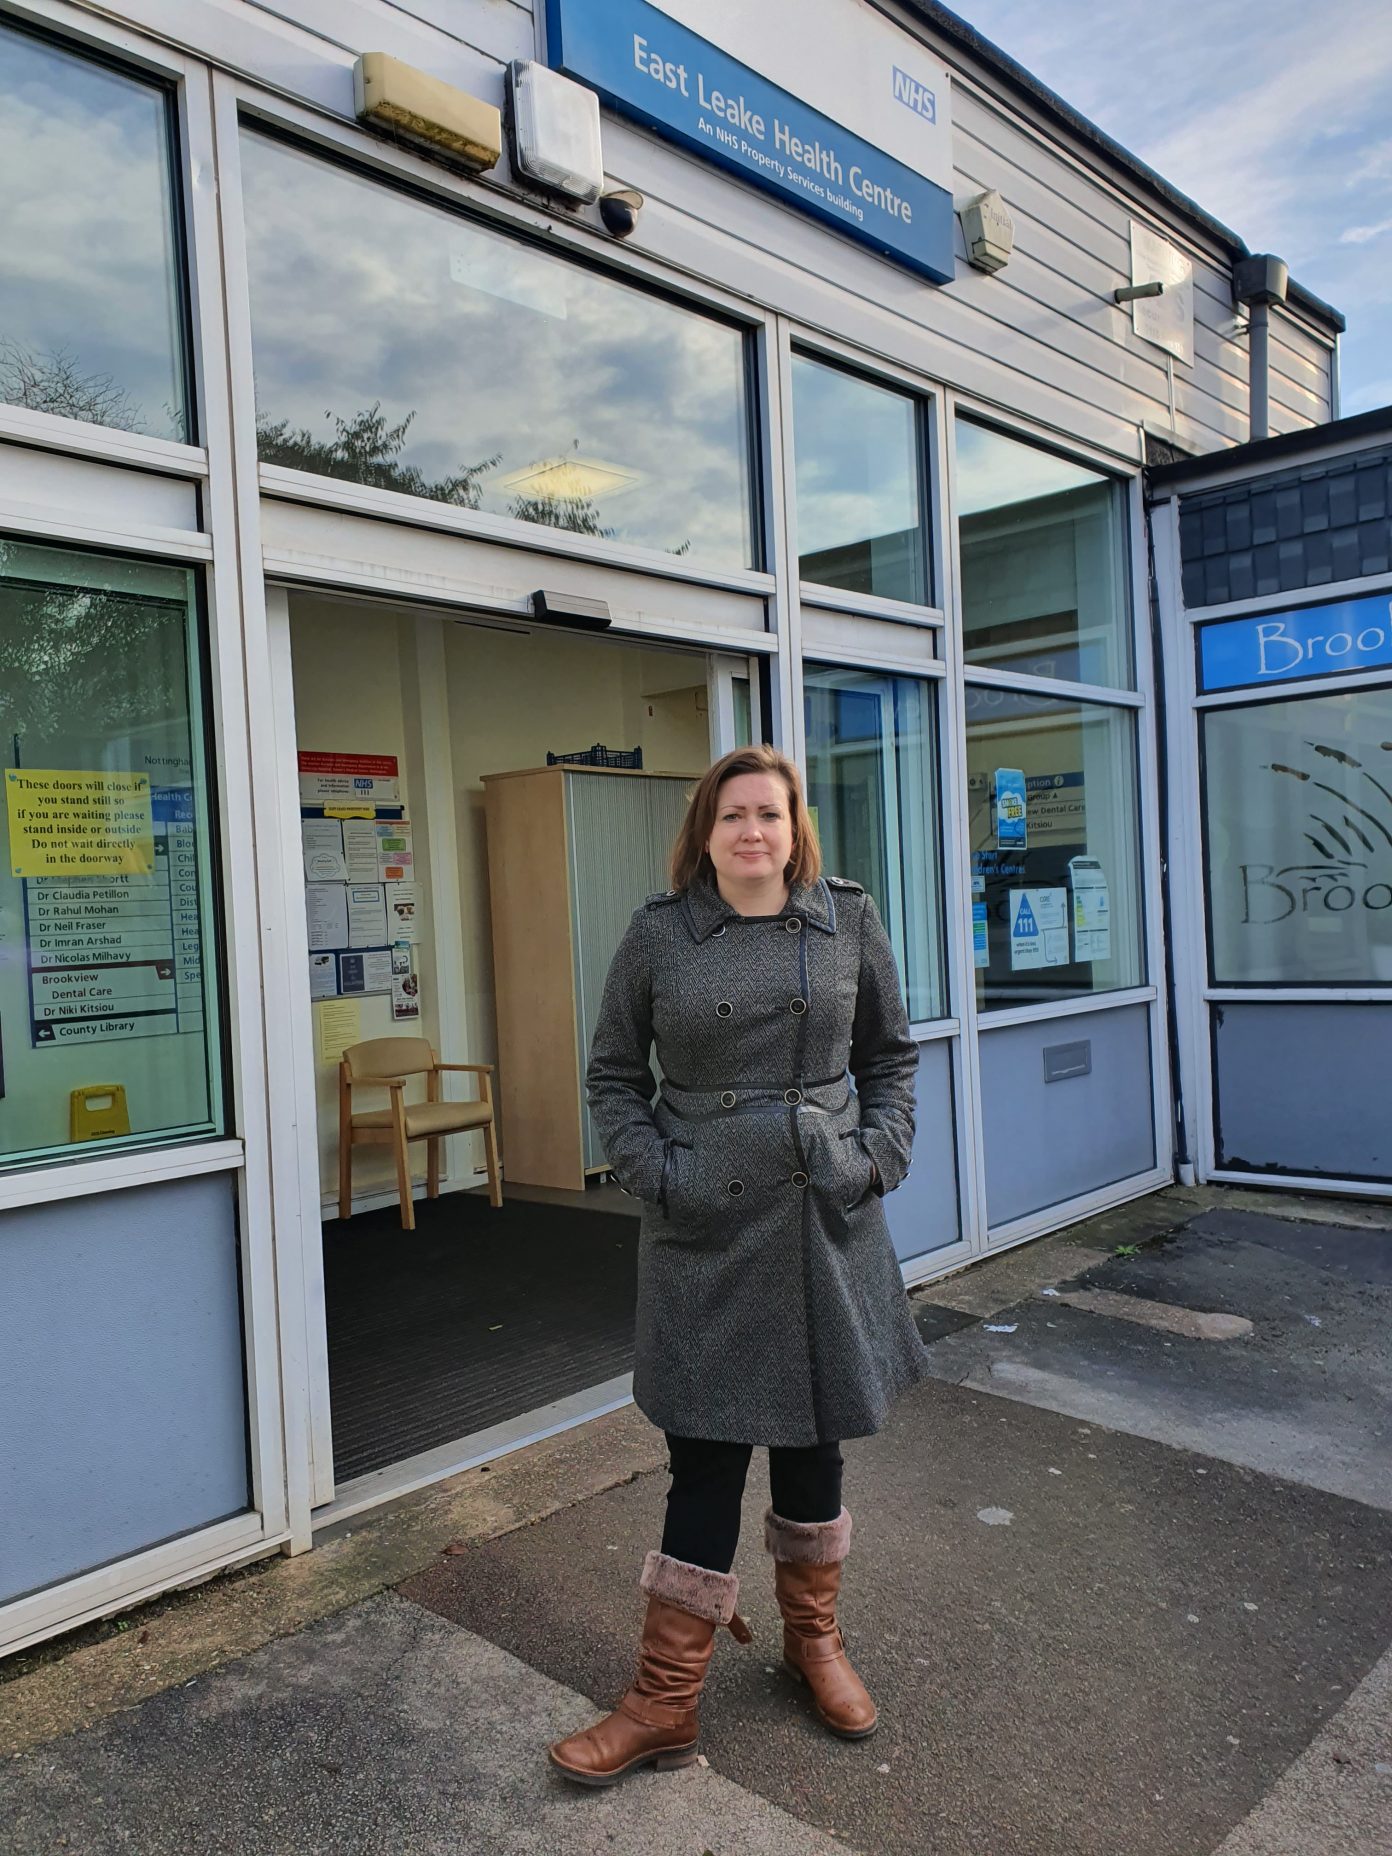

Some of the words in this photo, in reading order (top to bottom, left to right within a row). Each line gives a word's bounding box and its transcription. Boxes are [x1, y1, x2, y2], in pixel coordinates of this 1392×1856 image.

[895, 71, 934, 118] NHS
[633, 33, 689, 98] East
[697, 72, 765, 141] Leake
[773, 118, 843, 186] Health
[849, 166, 912, 224] Centre
[698, 117, 713, 137] An
[716, 126, 738, 150] NHS
[741, 140, 785, 178] Property
[787, 166, 825, 198] Services
[826, 188, 864, 222] building
[1256, 602, 1392, 675] Broo
[17, 779, 49, 789] These
[53, 780, 82, 790] doors
[86, 781, 104, 790] will
[107, 782, 131, 791] close
[134, 782, 142, 791] if
[356, 779, 372, 788] NHS
[38, 797, 57, 806] you
[60, 796, 89, 805] stand
[93, 796, 111, 805] still
[114, 798, 125, 806] so
[17, 809, 26, 818] if
[29, 811, 49, 821] you
[73, 810, 111, 821] waiting
[114, 811, 145, 821] please
[1041, 806, 1066, 814] Dental
[23, 824, 53, 834] stand
[57, 824, 87, 834] inside
[90, 826, 102, 834] or
[104, 824, 141, 834] outside
[32, 839, 48, 849] Do
[51, 840, 68, 849] not
[71, 840, 94, 849] wait
[96, 839, 136, 850] directly
[46, 854, 56, 864] in
[60, 854, 77, 863] the
[80, 854, 124, 865] doorway
[37, 891, 49, 900] Dr
[52, 890, 90, 900] Claudia
[92, 890, 129, 899] Petillon
[38, 907, 50, 916] Dr
[53, 906, 81, 915] Rahul
[84, 905, 119, 914] Mohan
[39, 923, 51, 932] Dr
[54, 922, 73, 931] Neil
[76, 922, 106, 930] Fraser
[1017, 918, 1033, 933] 111
[40, 939, 52, 948] Dr
[55, 938, 84, 947] Imran
[86, 935, 122, 946] Arshad
[41, 955, 53, 964] Dr
[54, 953, 90, 963] Nicolas
[92, 952, 131, 962] Milhavy
[42, 973, 99, 985] Brookview
[52, 988, 86, 999] Dental
[89, 987, 112, 997] Care
[44, 1008, 56, 1017] Dr
[59, 1006, 78, 1015] Niki
[80, 1003, 114, 1013] Kitsiou
[59, 1024, 97, 1036] County
[100, 1022, 135, 1032] Library
